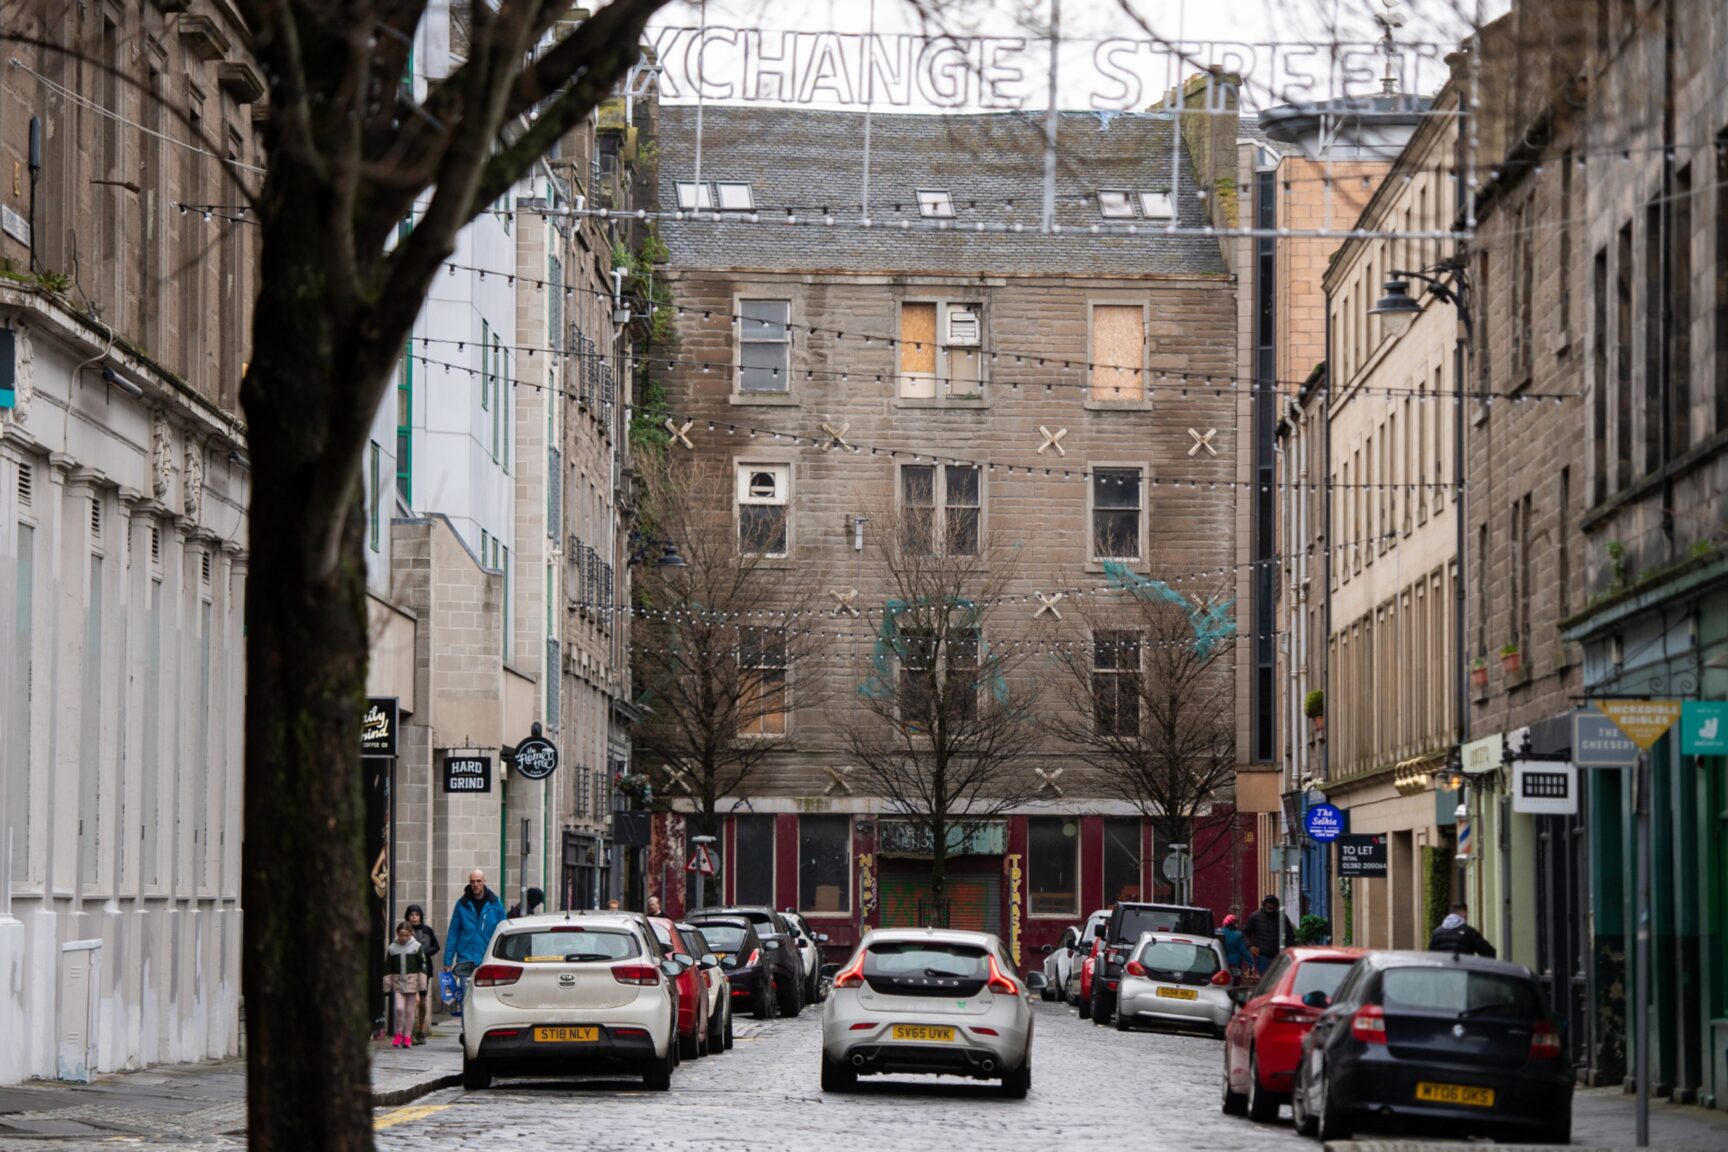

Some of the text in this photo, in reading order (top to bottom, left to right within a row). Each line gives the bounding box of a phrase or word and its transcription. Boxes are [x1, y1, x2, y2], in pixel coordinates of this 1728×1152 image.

[624, 26, 1438, 113] XCHANGE STREET
[1608, 705, 1679, 714] INCREDIBLE
[1620, 716, 1668, 725] EDIBLES
[1599, 728, 1619, 738] THE
[451, 760, 482, 774] HARD
[450, 777, 484, 789] GRIND
[1316, 808, 1333, 817] The
[1312, 817, 1338, 826] Selkie
[1342, 846, 1373, 855] TO LET
[892, 978, 959, 986] VOLVO
[541, 1028, 592, 1039] ST18 NLY
[897, 1027, 951, 1039] SV65 UVK
